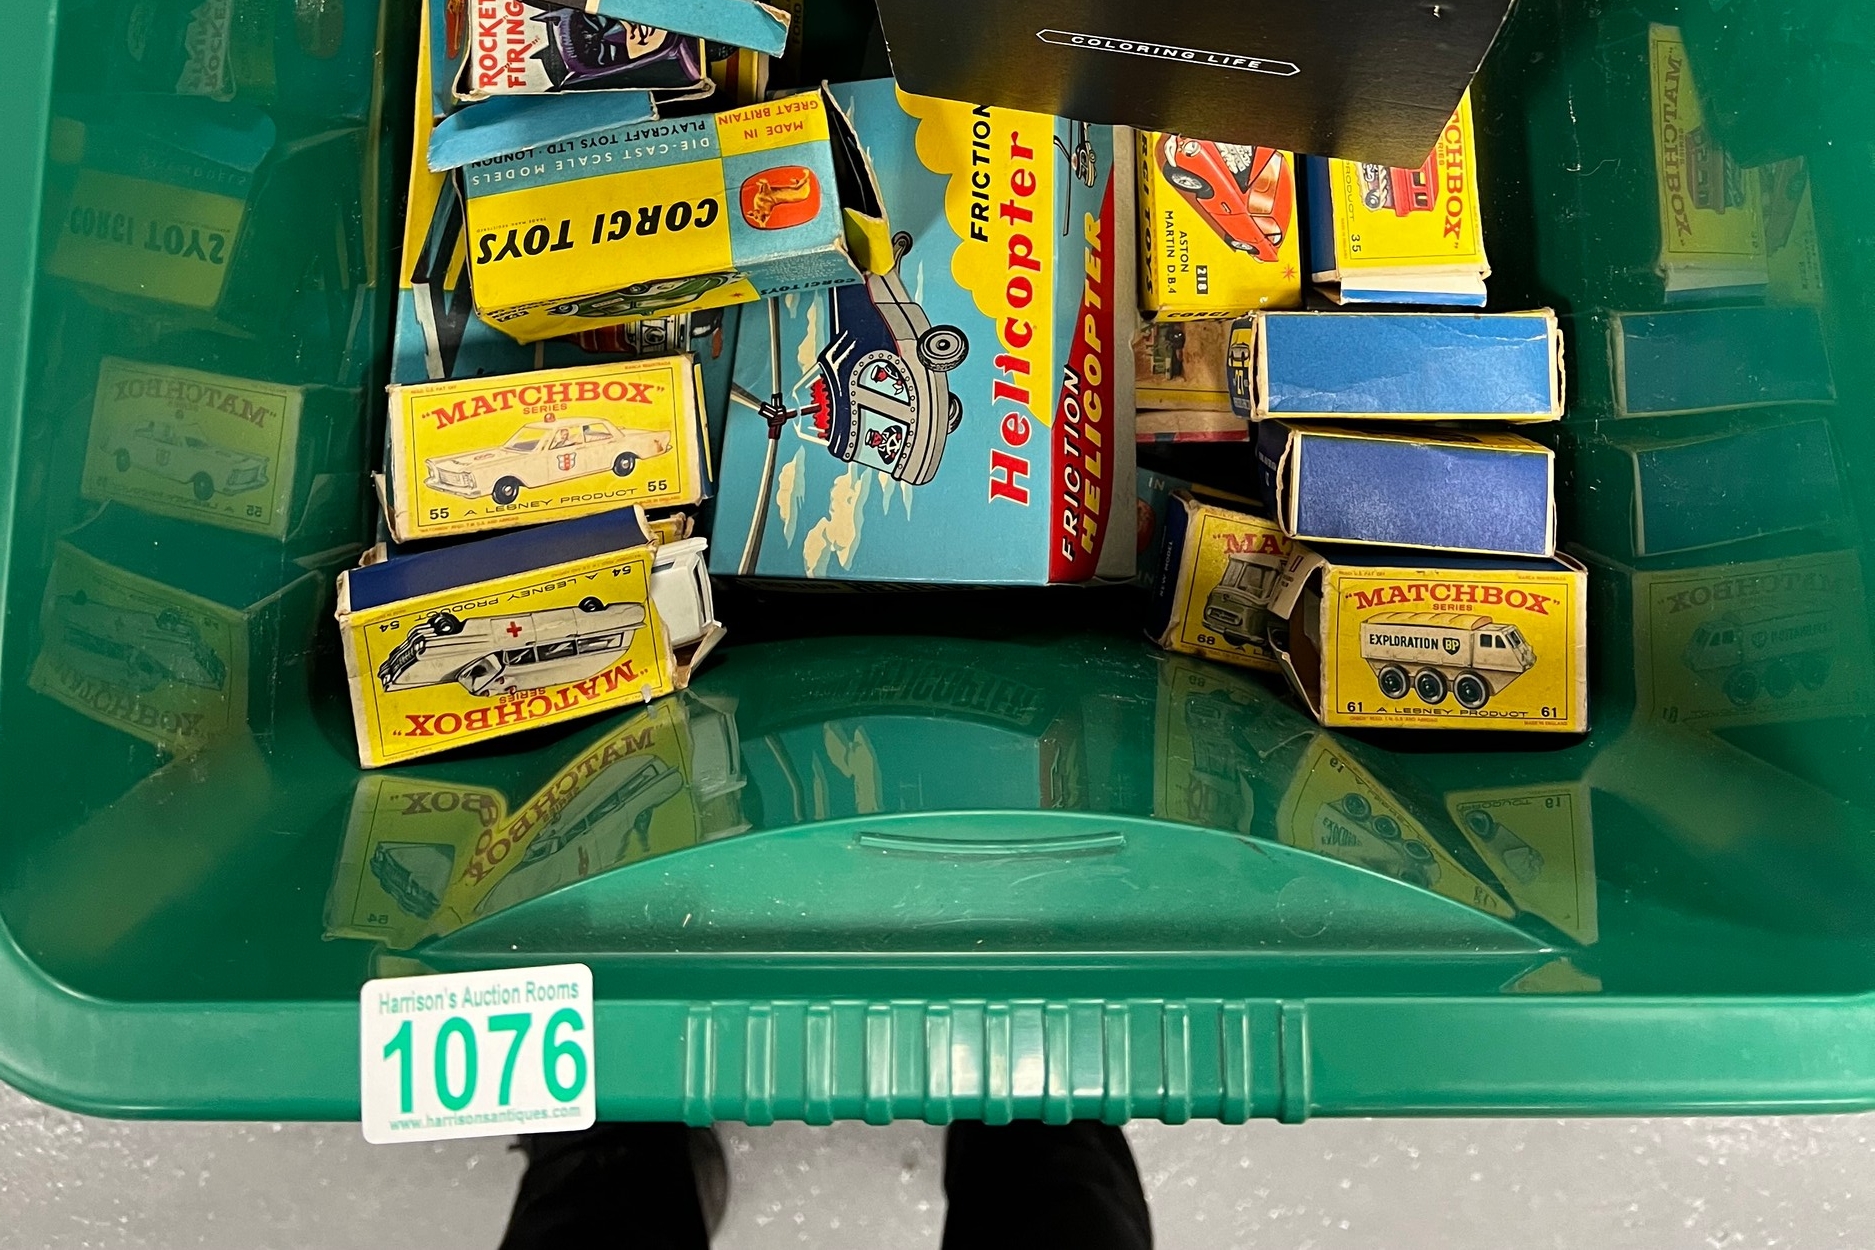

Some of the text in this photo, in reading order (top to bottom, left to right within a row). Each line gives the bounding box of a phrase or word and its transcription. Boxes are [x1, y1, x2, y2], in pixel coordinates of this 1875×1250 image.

[505, 0, 532, 89] FIRING
[1071, 36, 1262, 69] COLORING LIFE
[718, 100, 819, 125] GREAT BRITAIN
[580, 133, 618, 148] TOYS
[624, 120, 706, 141] PLAYCRAFT
[744, 121, 804, 140] MADE IN
[546, 141, 575, 154] LTD
[472, 137, 710, 186] DIE-CAST SCALE MODELS
[970, 104, 992, 243] FRICTION
[1142, 134, 1154, 295] RGI TOYS
[476, 197, 719, 265] CORGI TOYS
[1351, 234, 1361, 253] 35
[1165, 210, 1177, 294] MARTIN D.B.4
[1179, 230, 1189, 273] ASTON
[760, 278, 856, 295] CORGI TOYS
[1196, 266, 1208, 292] 218
[988, 131, 1036, 507] Helicopter
[1080, 211, 1104, 554] HELICOPTER
[523, 403, 568, 415] SERIES
[1061, 363, 1083, 563] FRICTION
[429, 507, 449, 520] 55
[485, 498, 553, 513] LESNEY
[560, 488, 638, 504] PRODUCT
[647, 479, 668, 492] 55
[612, 565, 632, 577] 54
[507, 578, 577, 601] LESNEY
[414, 597, 500, 622] PRODUCT
[1432, 603, 1473, 611] SERIES
[379, 621, 400, 633] 54
[1197, 634, 1216, 646] 68
[1369, 633, 1460, 652] EXPLORATION BP
[498, 686, 546, 704] SERIES
[1347, 702, 1364, 713] 61
[1394, 707, 1453, 716] LESNEY
[1459, 709, 1529, 718] PRODUCT
[1541, 707, 1558, 718] 61
[378, 981, 579, 1015] Harrison's Auction Rooms
[383, 1008, 588, 1114] 1076
[389, 1106, 582, 1132] www.harrisonsantiques.com
